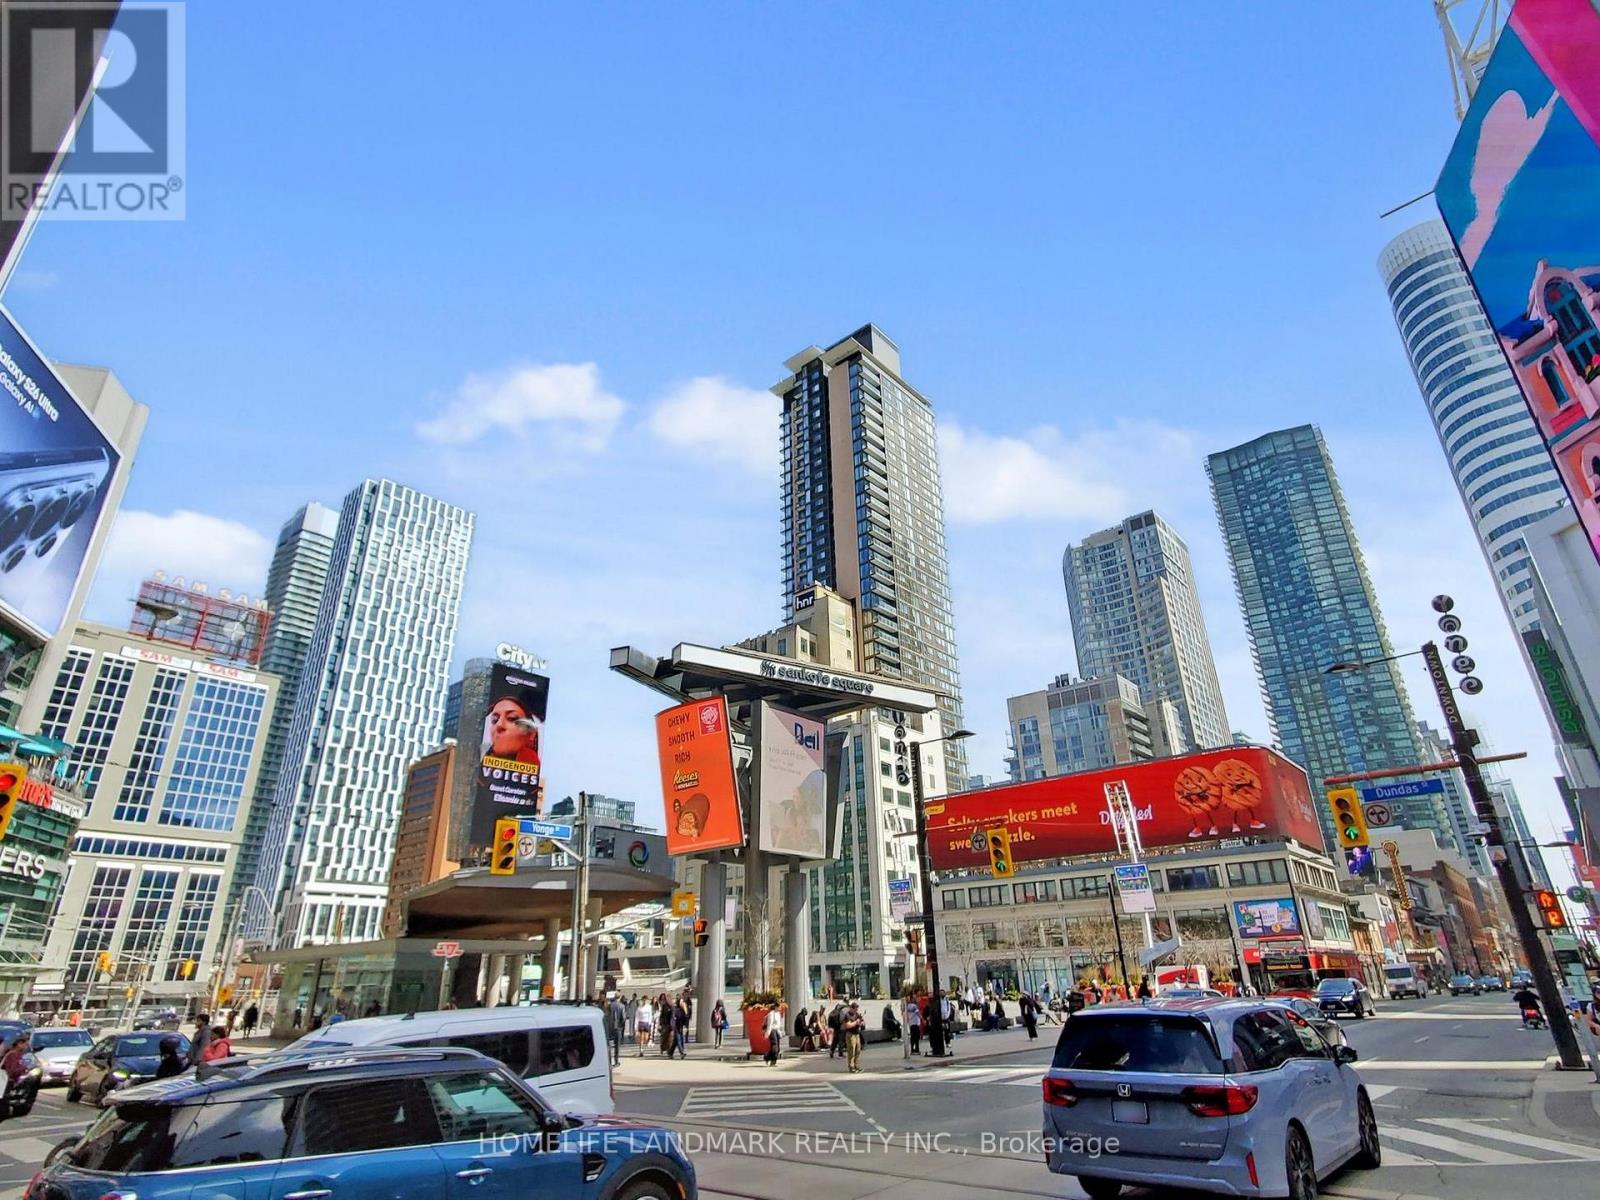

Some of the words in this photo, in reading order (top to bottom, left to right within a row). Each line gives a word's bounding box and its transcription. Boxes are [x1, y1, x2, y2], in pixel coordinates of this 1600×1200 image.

[38, 393, 59, 422] Ultra
[1426, 651, 1458, 724] DOWNTOWN
[667, 712, 690, 728] CHEWY
[668, 730, 696, 747] SMOOTH
[484, 757, 537, 774] INDIGENOUS
[674, 750, 691, 764] RICH
[482, 767, 538, 785] VOICES
[1375, 784, 1419, 798] Dundas
[1041, 802, 1078, 819] meet
[532, 821, 555, 836] Yonge
